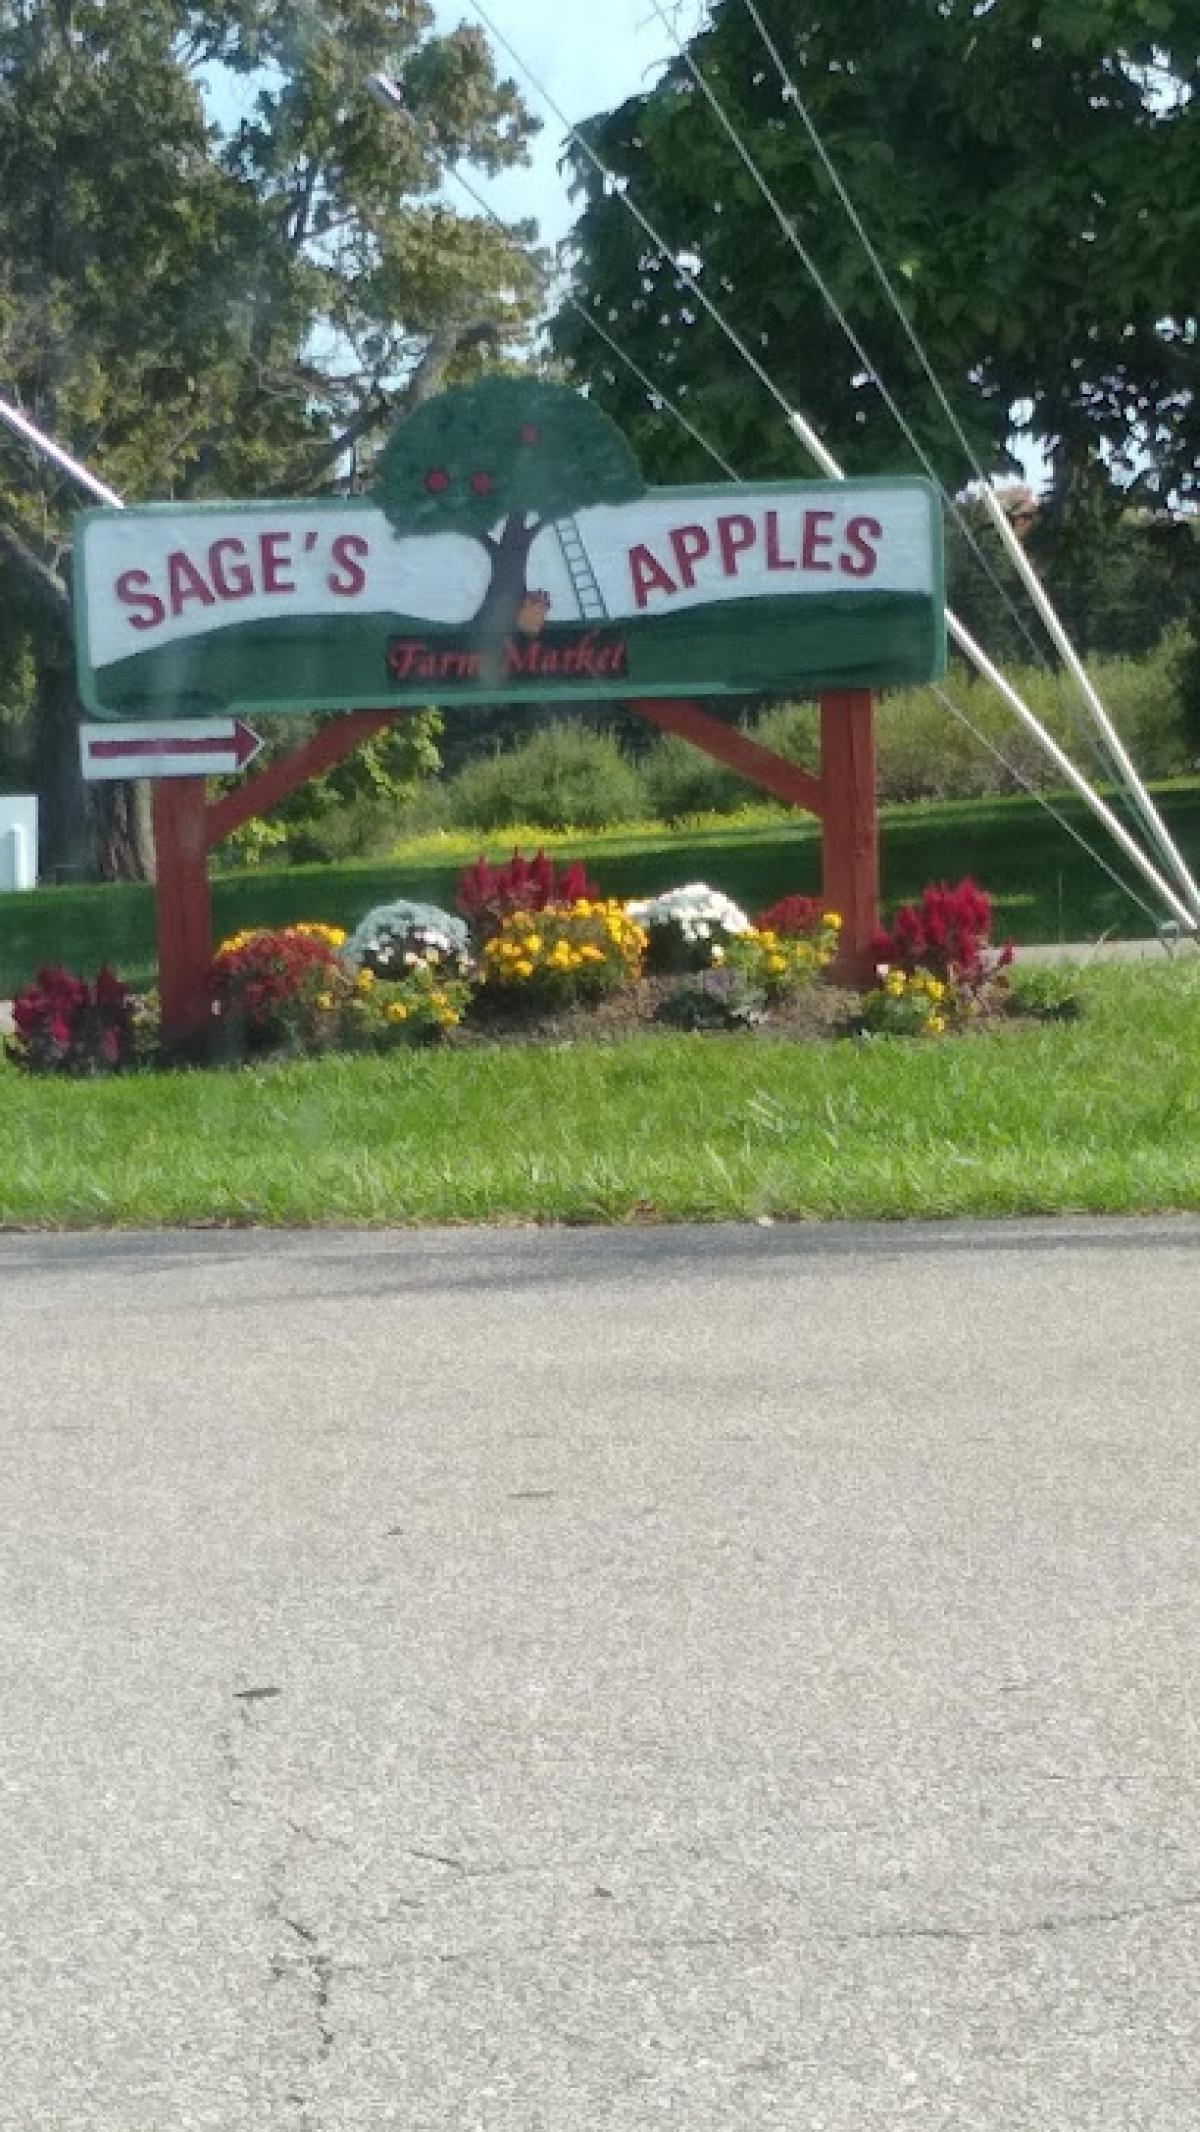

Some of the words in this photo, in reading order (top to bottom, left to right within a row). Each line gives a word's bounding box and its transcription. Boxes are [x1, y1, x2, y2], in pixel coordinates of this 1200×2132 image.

[114, 530, 369, 630] SAGE'S
[628, 510, 883, 609] APPLES
[388, 639, 482, 679] Farm
[505, 630, 627, 677] Market
